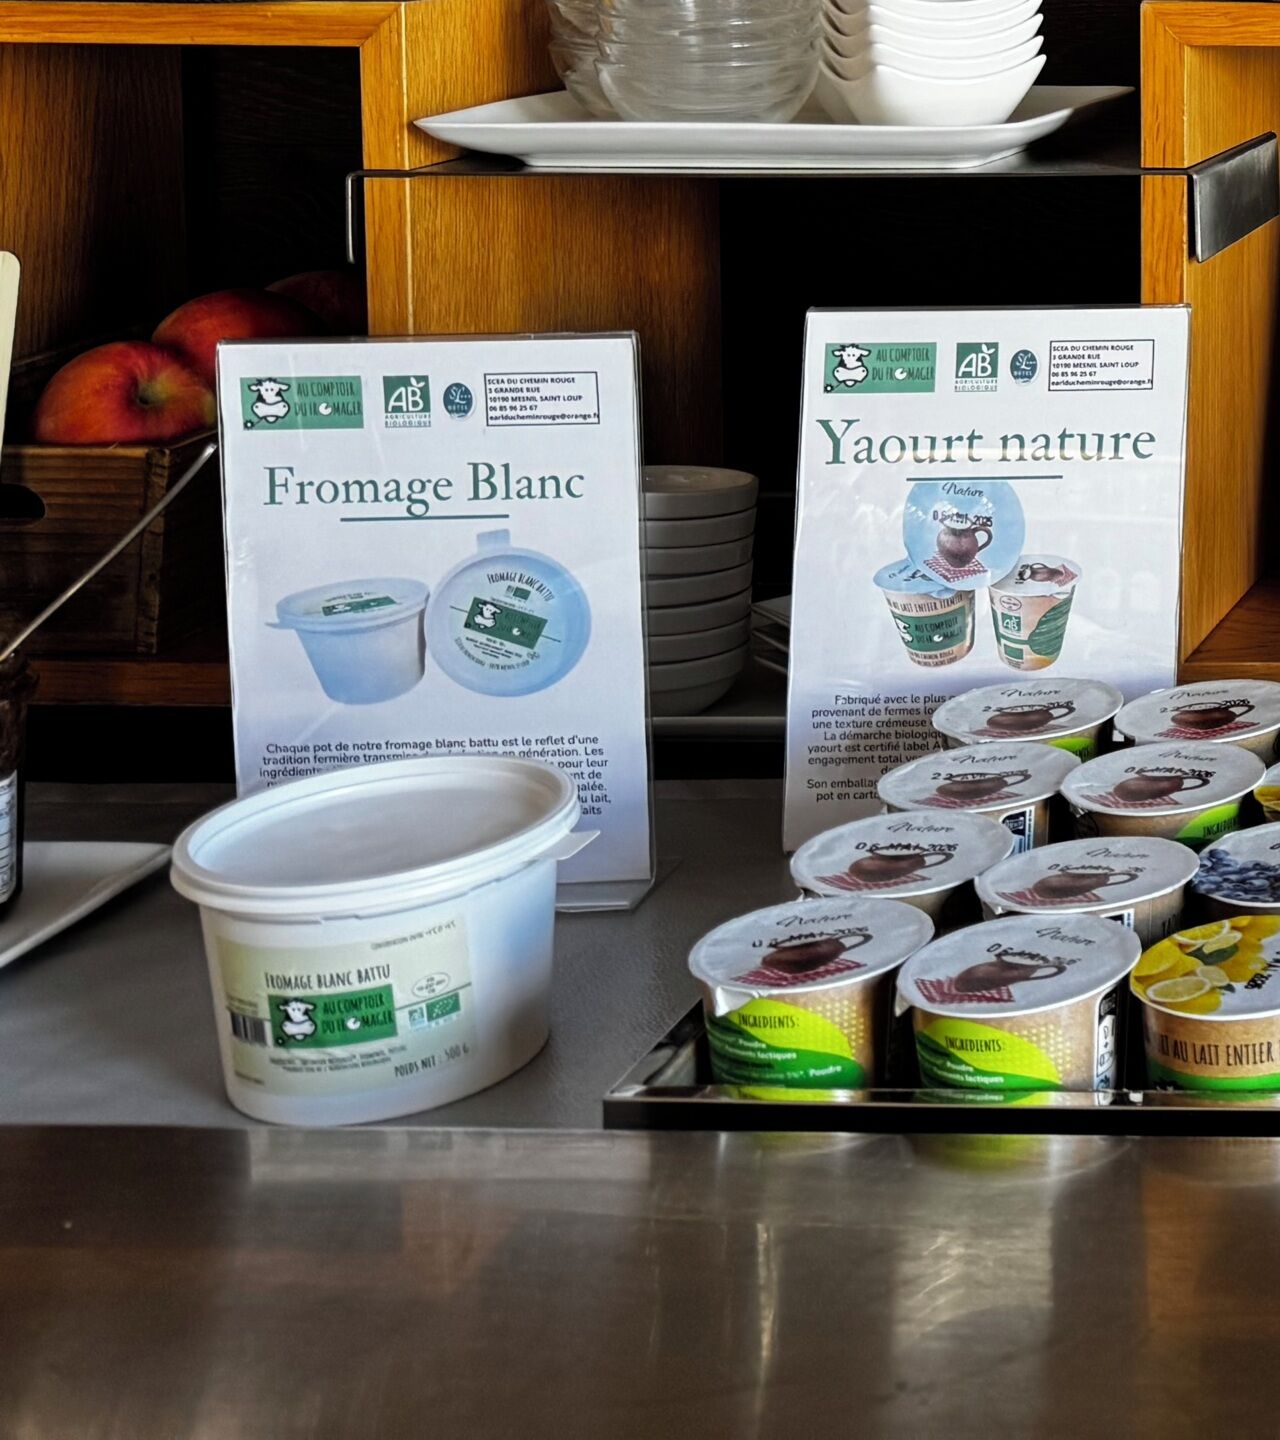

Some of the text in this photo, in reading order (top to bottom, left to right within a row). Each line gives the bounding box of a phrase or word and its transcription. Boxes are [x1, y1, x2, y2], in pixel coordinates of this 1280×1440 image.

[958, 354, 994, 377] AB
[388, 387, 424, 412] AB
[816, 418, 1156, 465] Yaourt nature
[263, 462, 584, 515] Fromage Blanc
[264, 963, 390, 989] FROMAGE BLANC BATTU
[1173, 1040, 1188, 1062] AU
[1194, 1043, 1221, 1065] LAIT
[1226, 1042, 1275, 1066] ENTIER
[395, 1063, 419, 1077] POIDS
